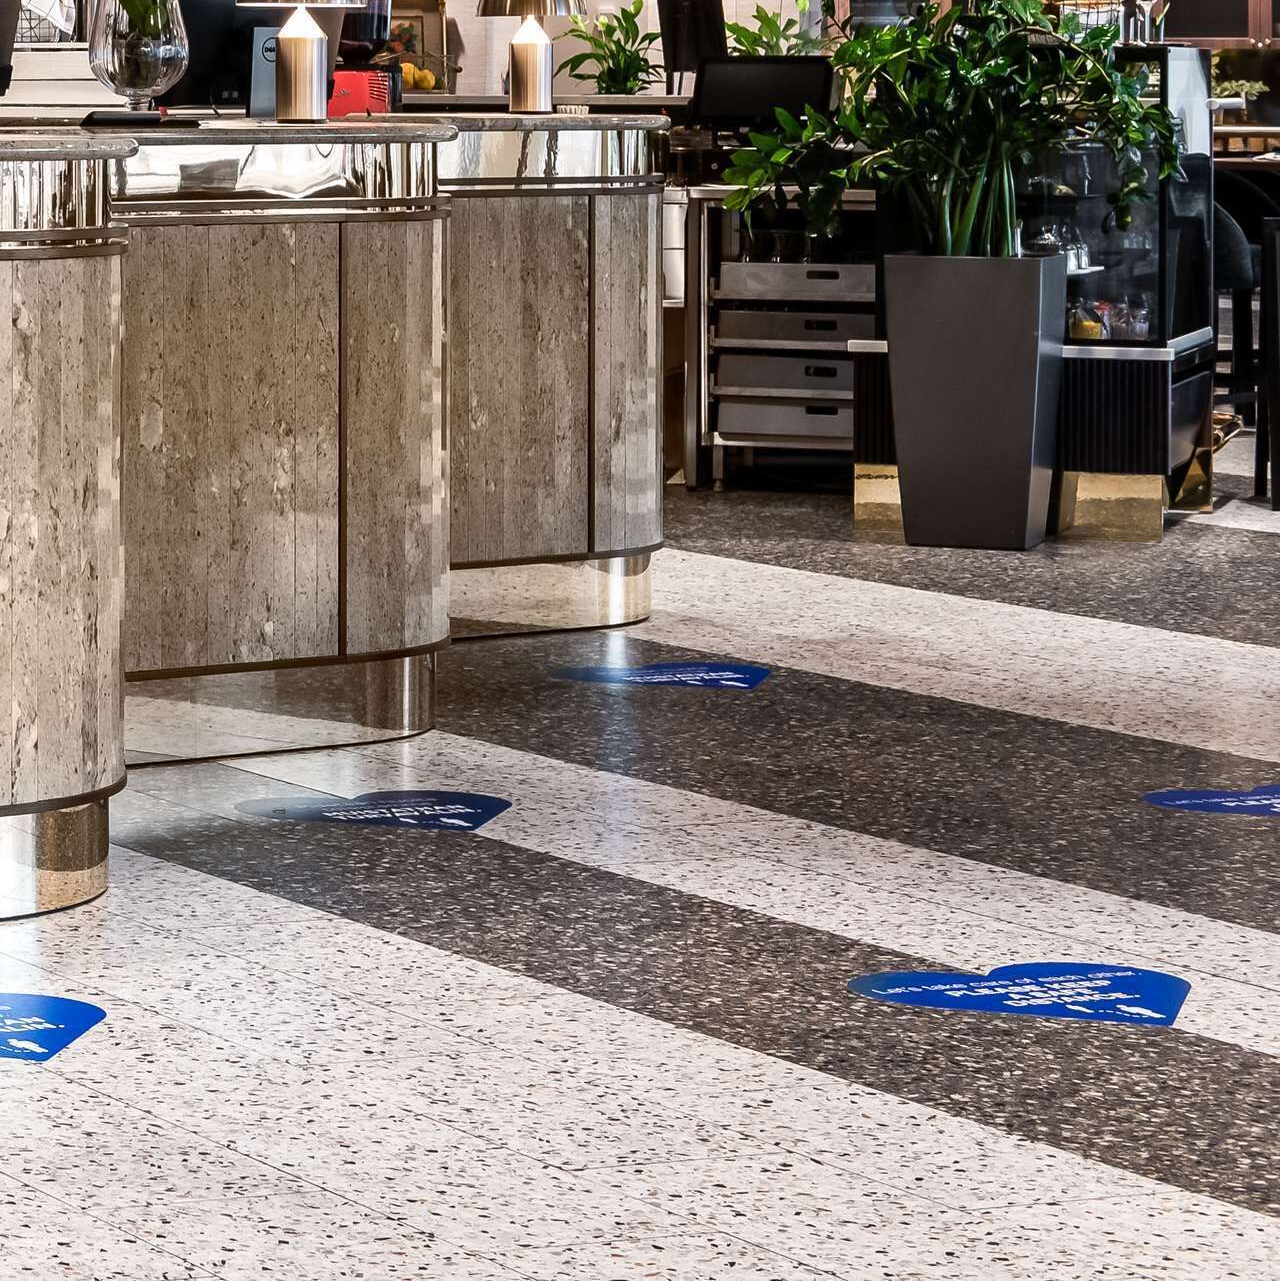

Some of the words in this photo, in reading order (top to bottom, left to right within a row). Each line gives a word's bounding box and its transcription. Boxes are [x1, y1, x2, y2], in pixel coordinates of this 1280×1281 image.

[943, 983, 1048, 997] PLEASE
[1044, 979, 1111, 990] KEEP
[1028, 988, 1100, 998] SAFE
[1002, 992, 1141, 1007] DISTANCE.
